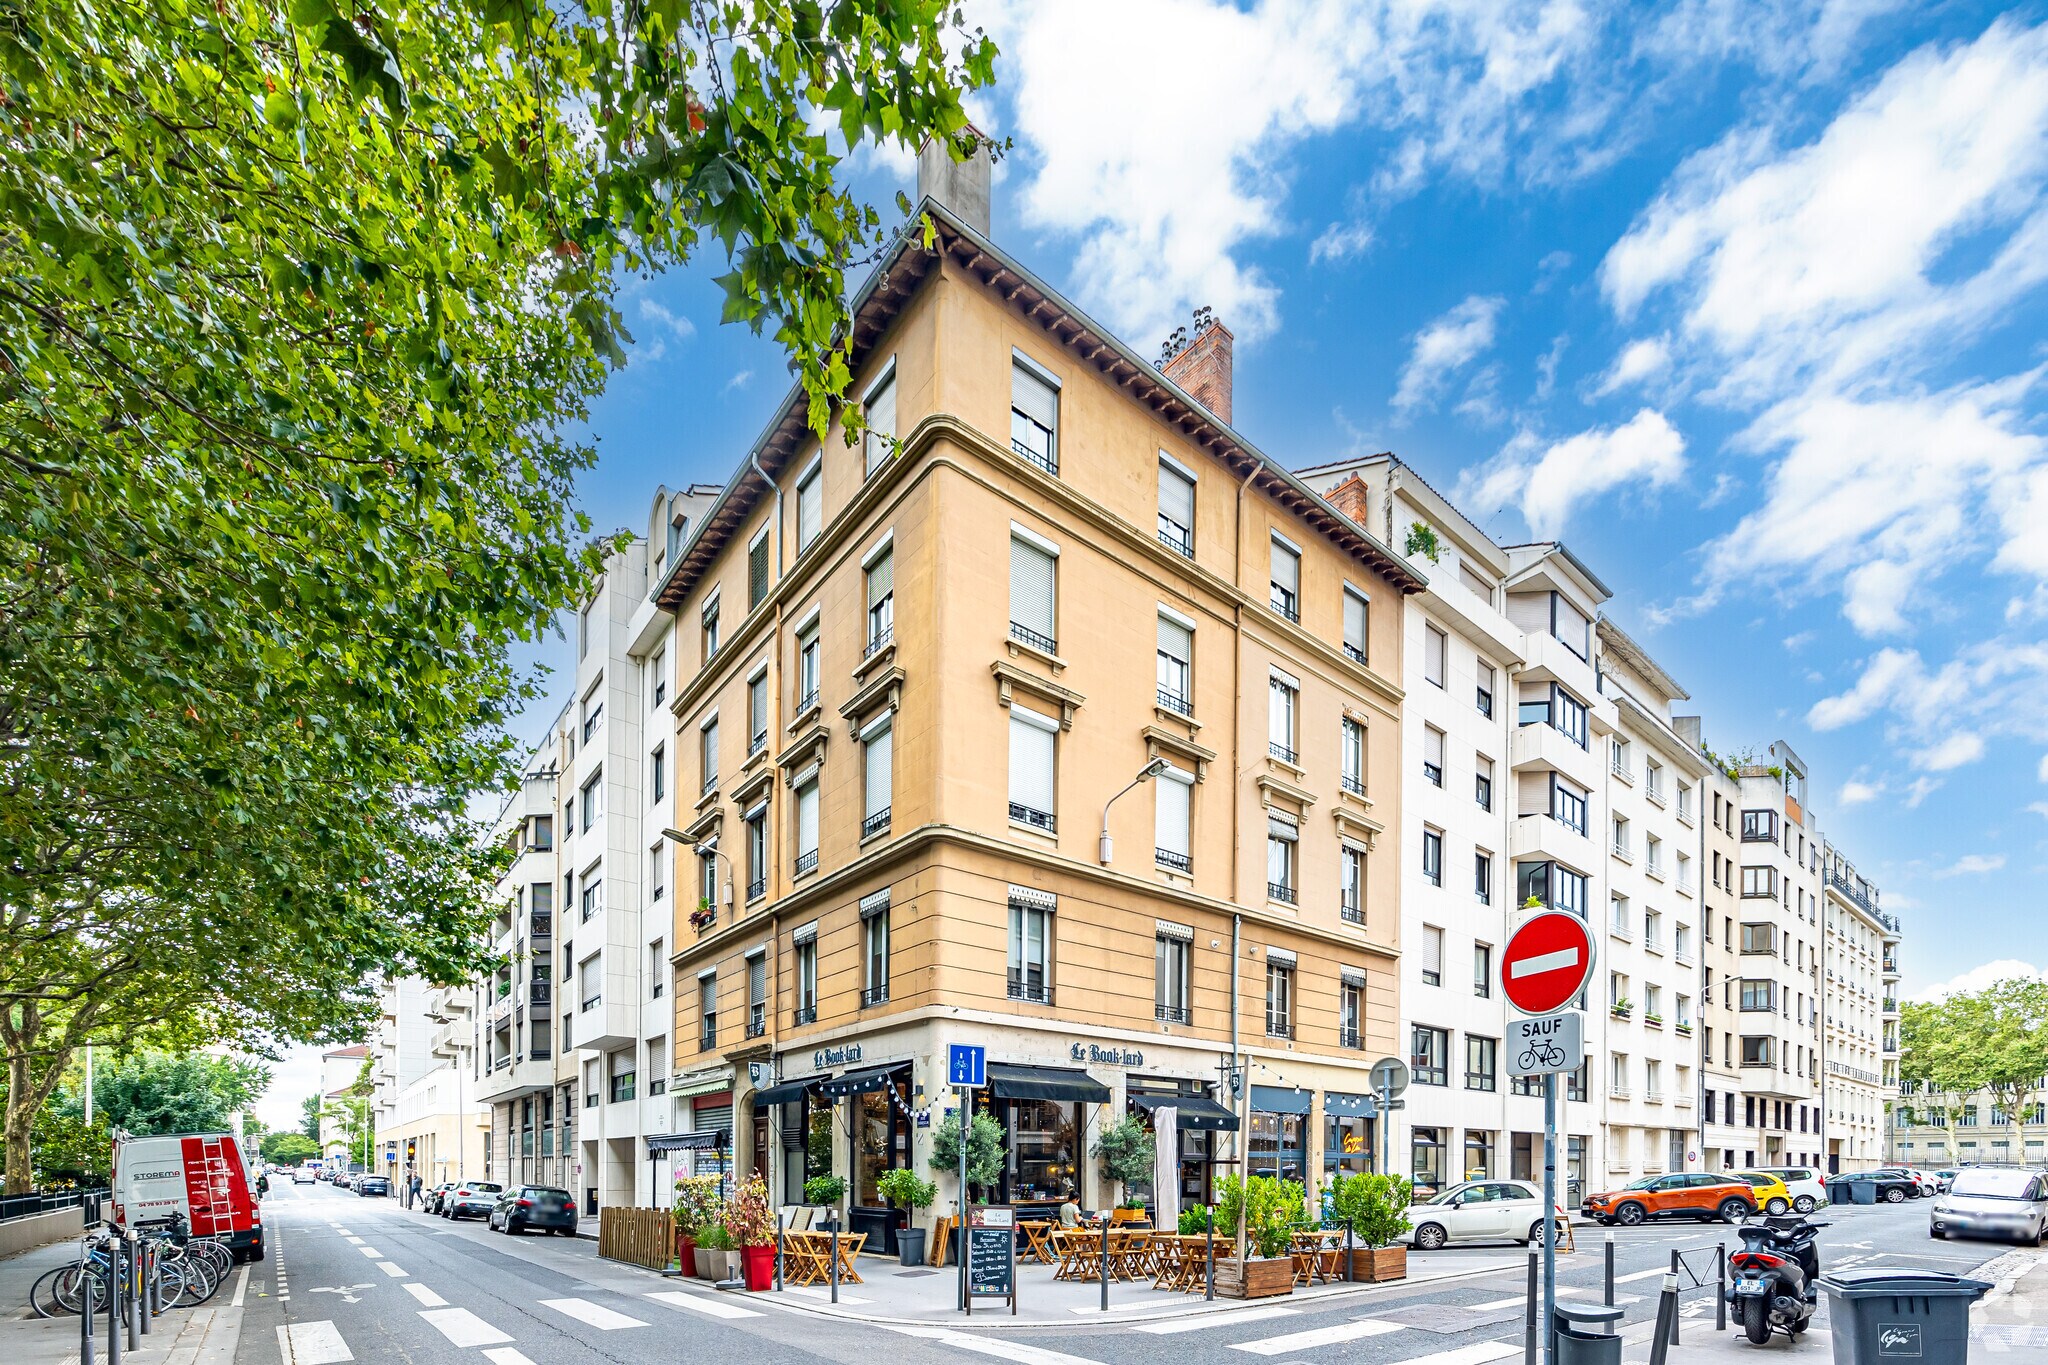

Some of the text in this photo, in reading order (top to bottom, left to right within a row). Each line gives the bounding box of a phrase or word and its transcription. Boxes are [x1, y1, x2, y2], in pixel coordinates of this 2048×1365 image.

[1521, 1018, 1562, 1038] SAUF
[1071, 1042, 1087, 1060] Le
[814, 1050, 823, 1067] Le
[751, 1066, 759, 1077] B
[1232, 1076, 1239, 1088] B
[133, 1170, 180, 1180] STOREMA
